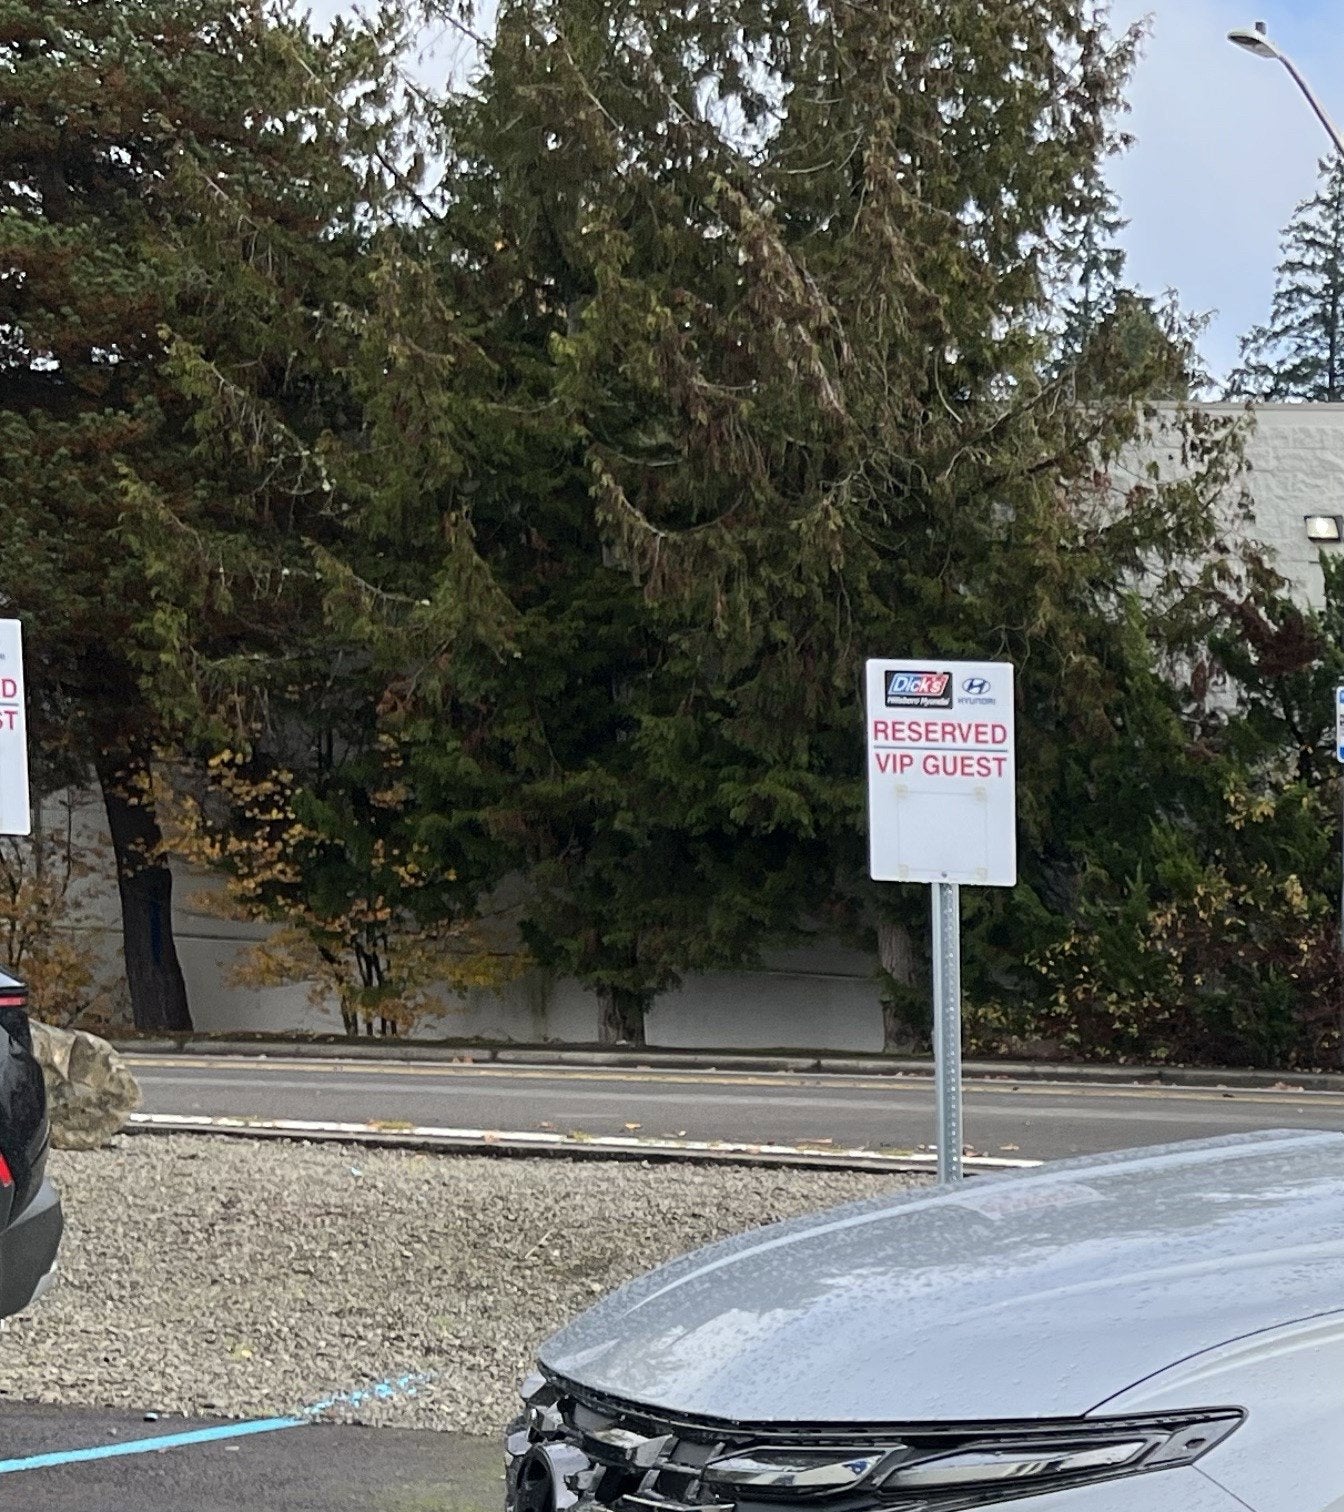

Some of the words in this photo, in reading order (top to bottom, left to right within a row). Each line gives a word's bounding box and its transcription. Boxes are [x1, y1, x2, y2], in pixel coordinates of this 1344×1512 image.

[893, 674, 944, 694] Dick's
[956, 697, 996, 706] HYUNDAI
[873, 720, 1007, 745] RESERVED
[875, 753, 914, 775] VIP
[922, 755, 1008, 778] GUEST
